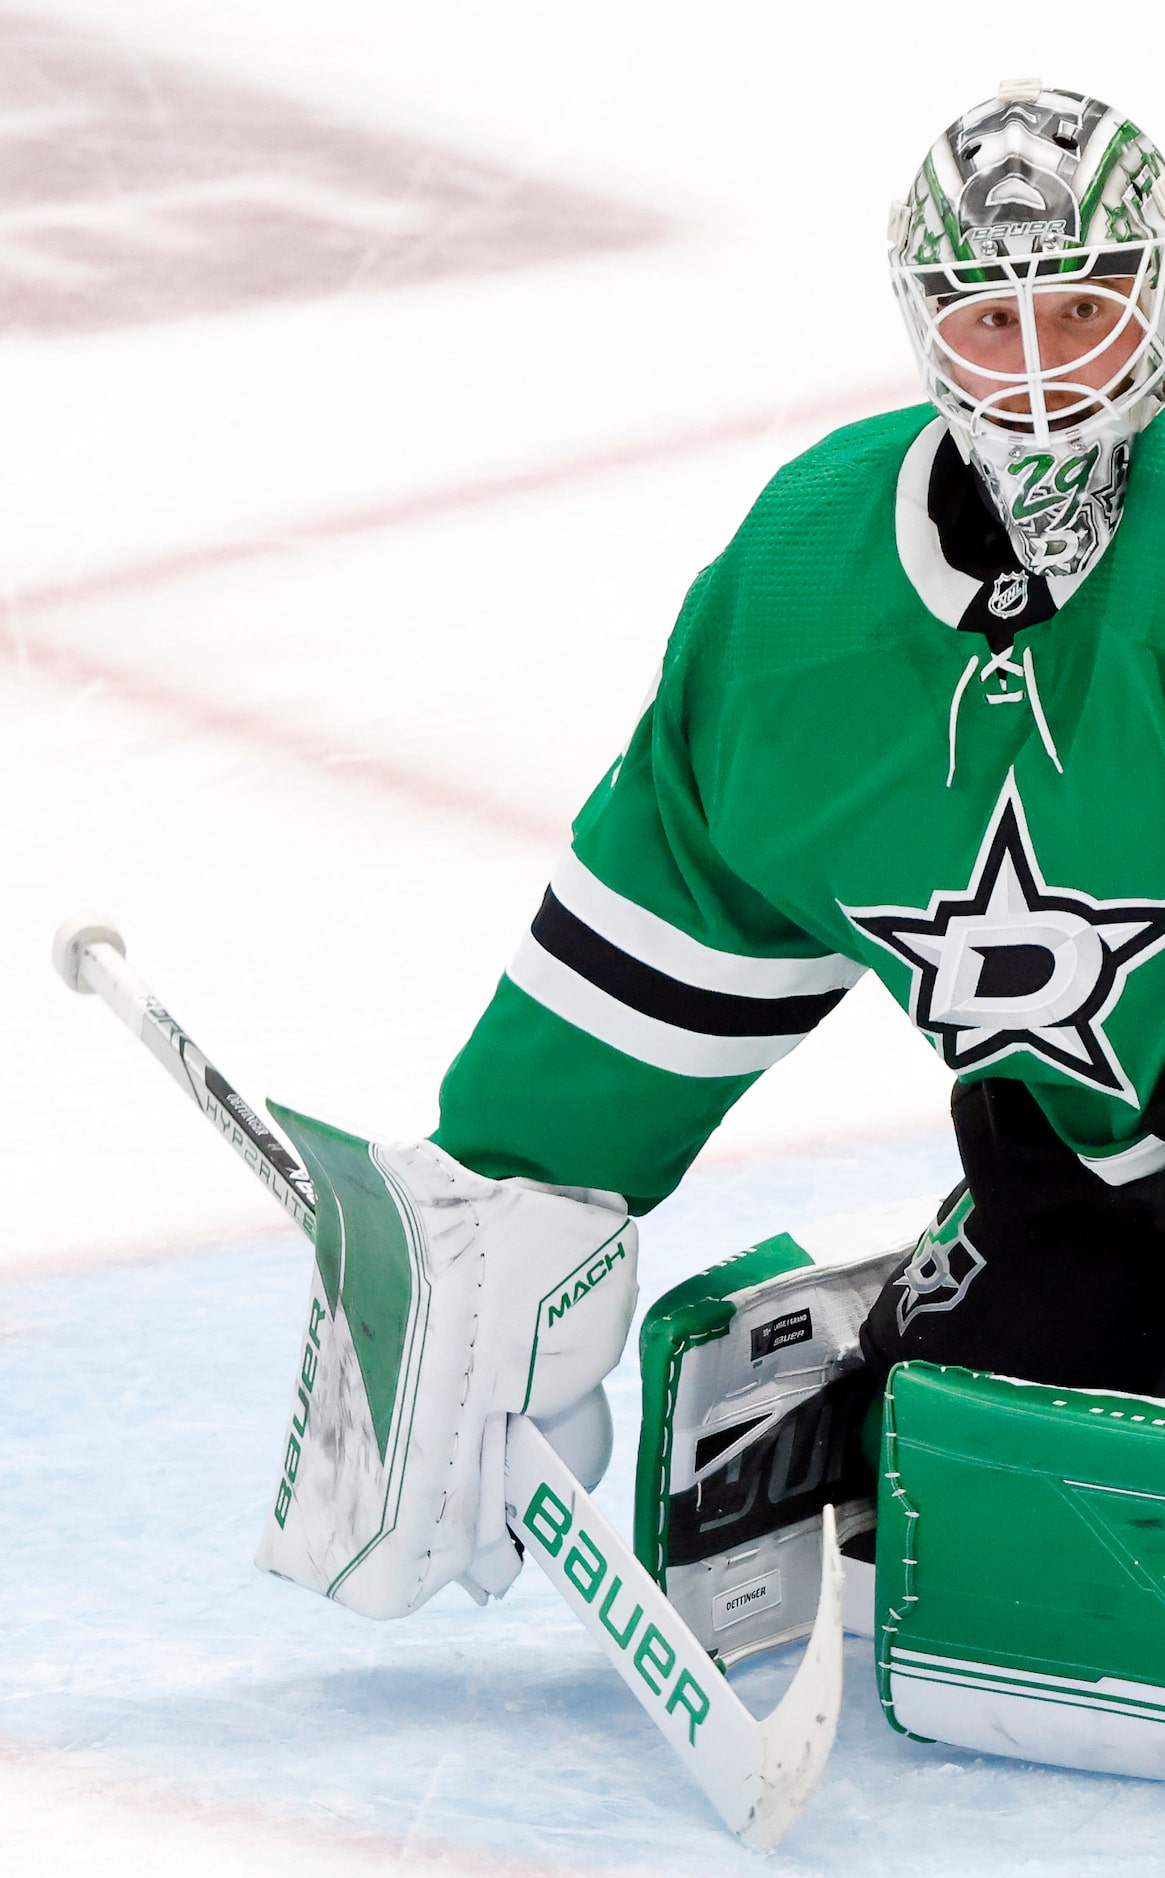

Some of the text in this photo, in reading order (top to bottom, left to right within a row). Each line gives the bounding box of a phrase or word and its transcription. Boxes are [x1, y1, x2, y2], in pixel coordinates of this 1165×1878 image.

[1008, 442, 1101, 531] 29
[997, 581, 1024, 610] NHL
[547, 1241, 626, 1328] MACH
[274, 1297, 327, 1530] BAUER
[522, 1482, 710, 1748] BAUER
[725, 1586, 767, 1612] OETTINGER
